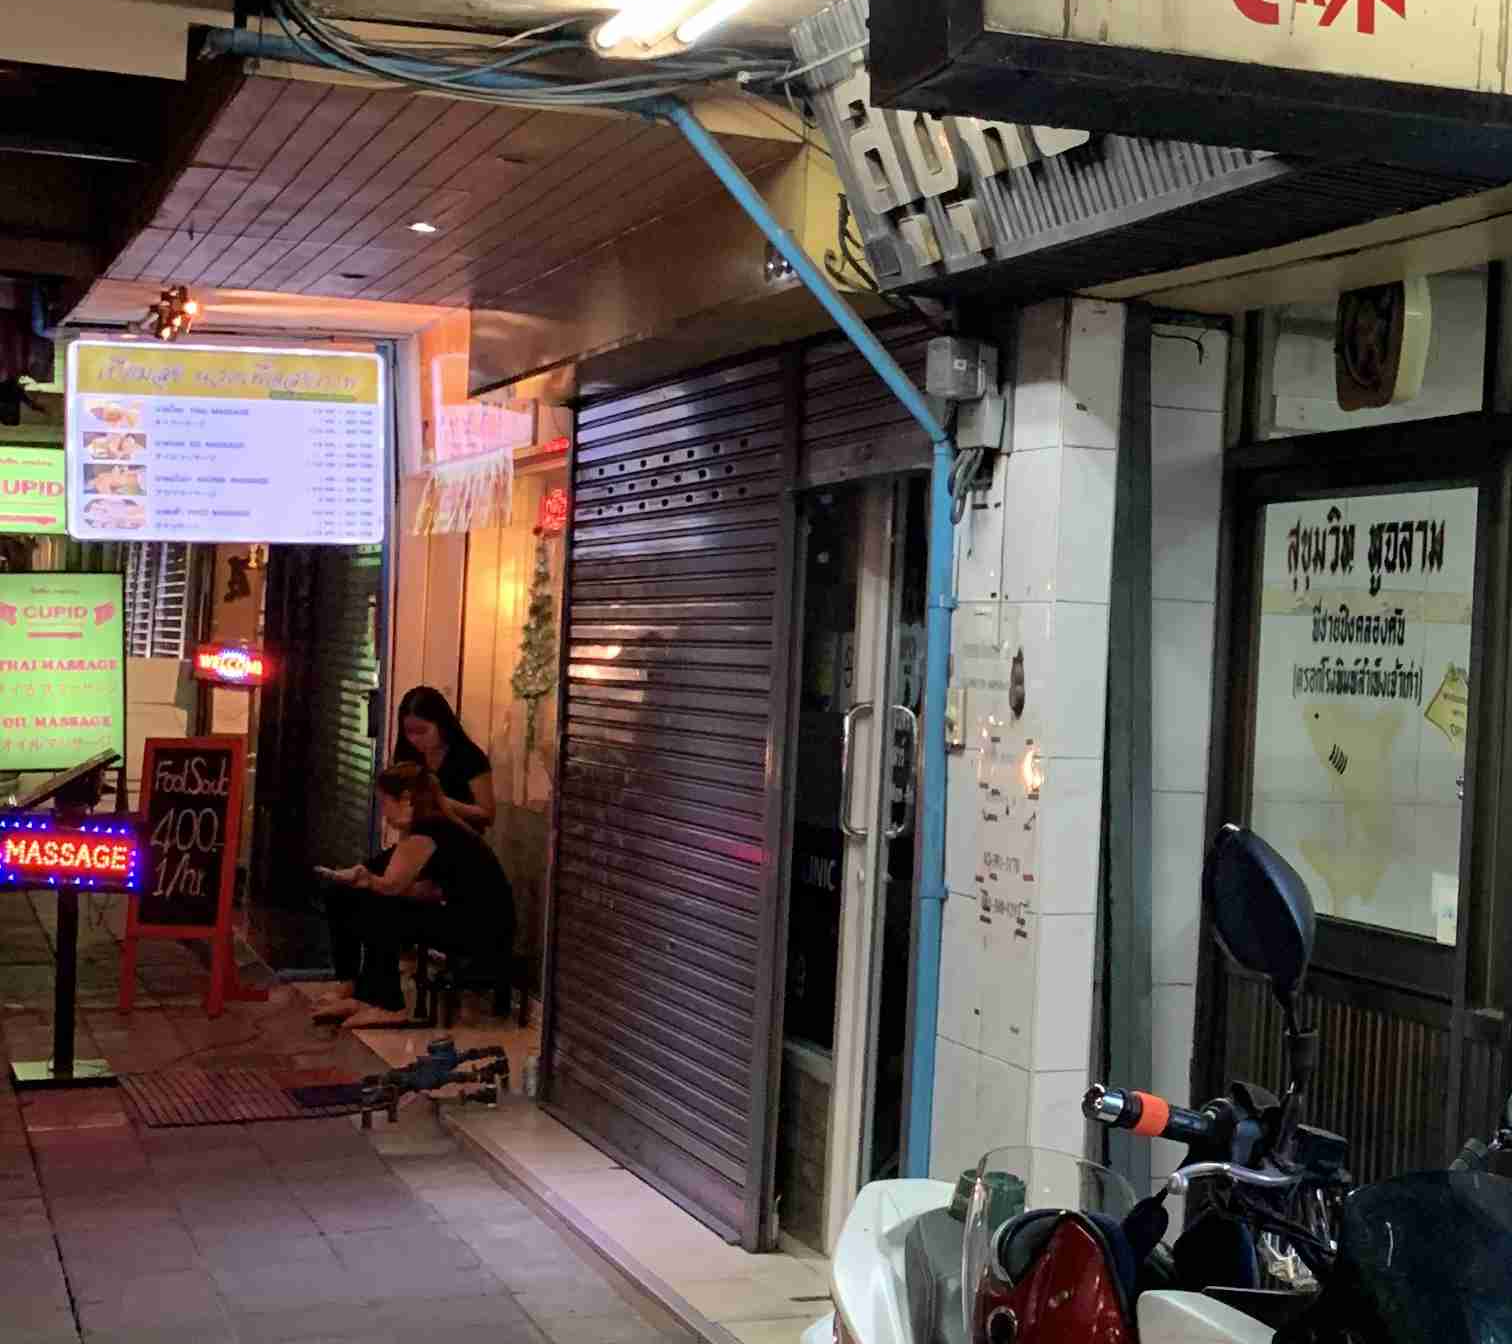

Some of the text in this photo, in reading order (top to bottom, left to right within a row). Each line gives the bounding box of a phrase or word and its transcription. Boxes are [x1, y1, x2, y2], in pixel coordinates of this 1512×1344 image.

[21, 605, 88, 619] CUPID
[35, 716, 113, 729] MASSAGE
[3, 838, 128, 870] MASSAGE
